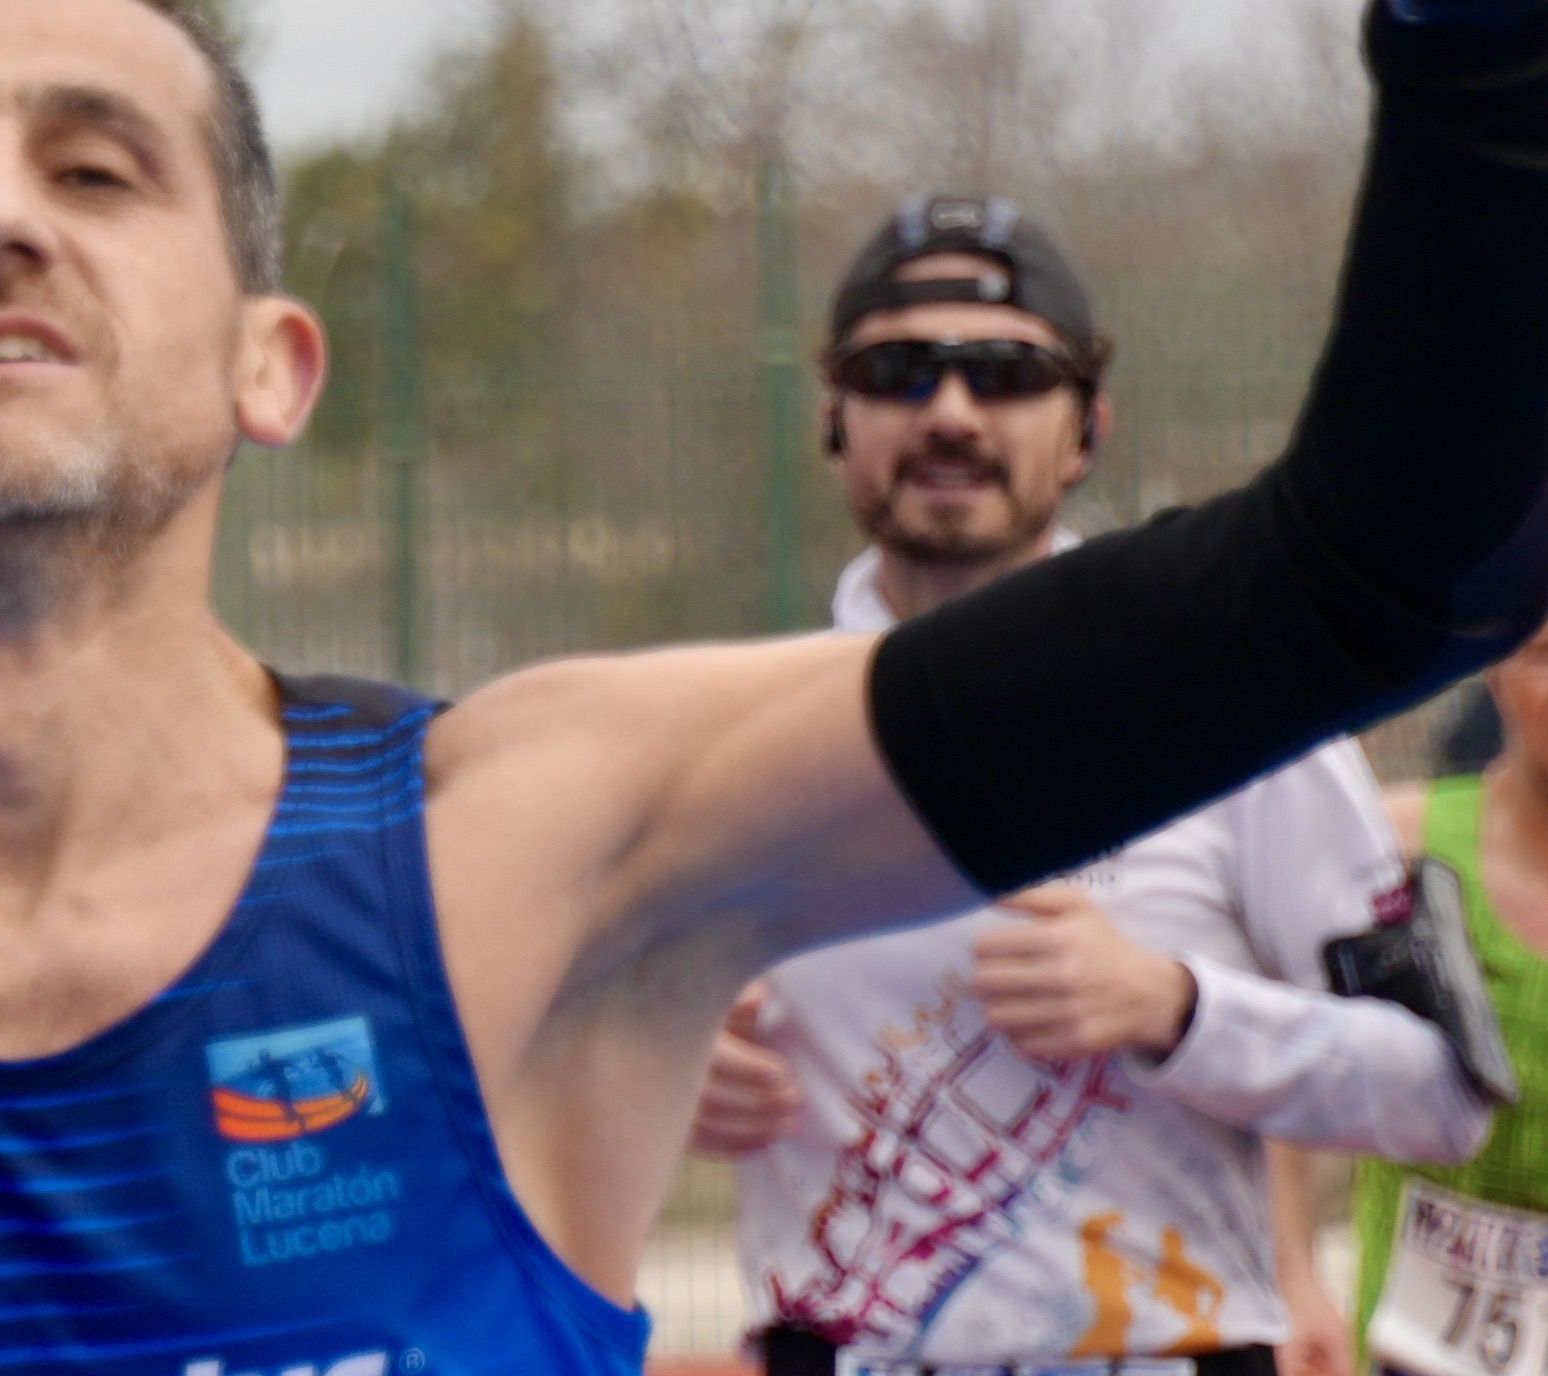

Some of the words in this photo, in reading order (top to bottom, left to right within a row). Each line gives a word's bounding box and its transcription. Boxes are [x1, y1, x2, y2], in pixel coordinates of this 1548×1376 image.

[227, 1141, 322, 1187] Club
[233, 1165, 399, 1225] Maratón
[240, 1212, 392, 1266] Lucena
